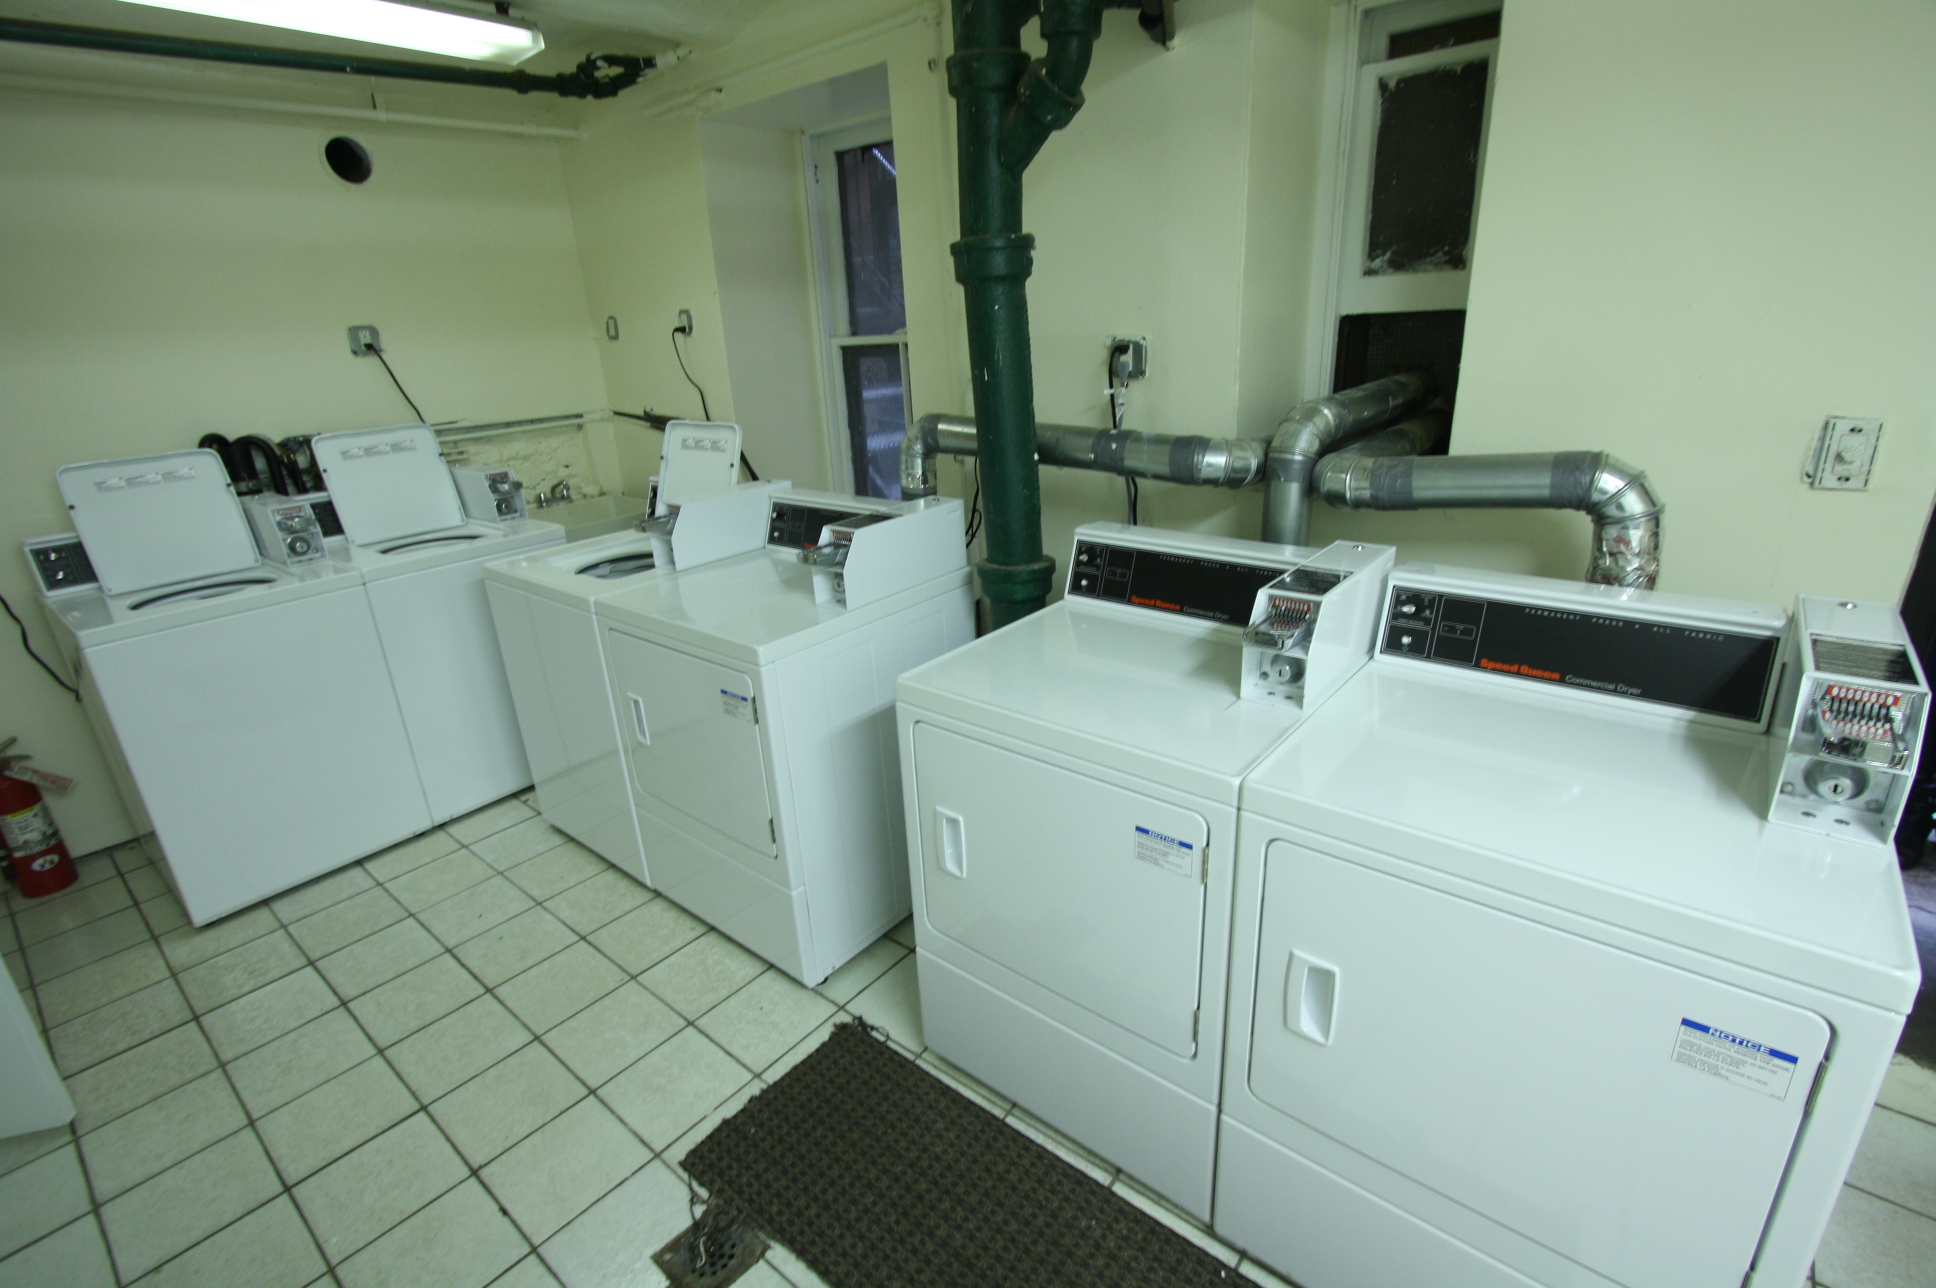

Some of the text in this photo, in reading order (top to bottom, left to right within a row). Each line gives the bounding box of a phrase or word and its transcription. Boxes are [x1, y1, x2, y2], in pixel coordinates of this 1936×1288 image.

[1130, 594, 1230, 620] Speed Queen Commercial Dryer
[1525, 608, 1580, 620] PERMANENT
[1591, 617, 1624, 628] PRESS
[1652, 626, 1671, 634] ALL
[1684, 630, 1725, 642] FABRIC
[1480, 657, 1643, 696] Speed Queen Commercial Dryer
[1708, 1027, 1771, 1055] NOTICE
